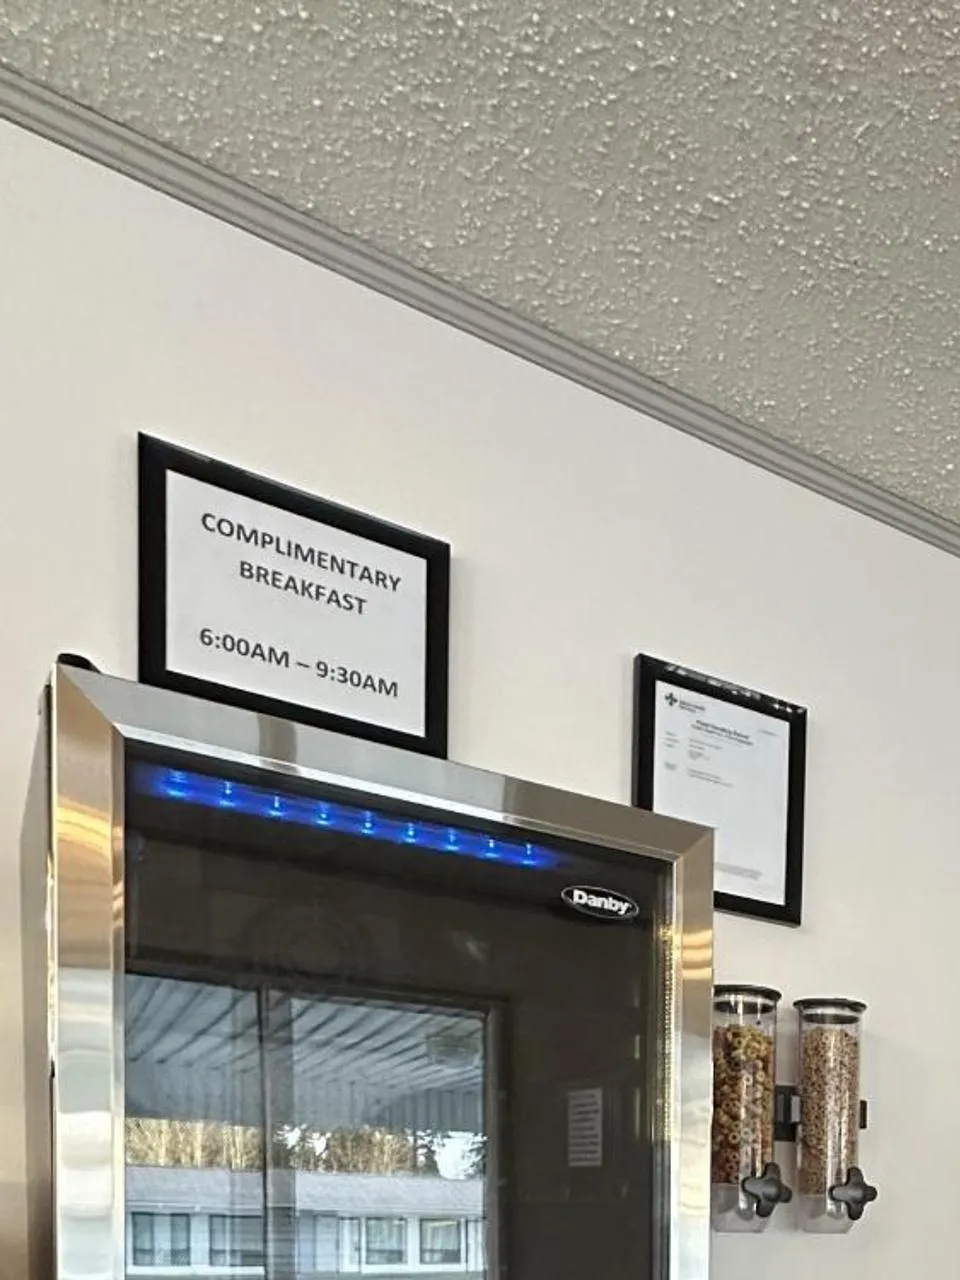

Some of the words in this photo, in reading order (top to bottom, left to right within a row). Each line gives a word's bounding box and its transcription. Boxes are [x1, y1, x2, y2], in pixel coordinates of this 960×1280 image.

[201, 512, 402, 592] COMPLIMENTARY
[239, 560, 367, 615] BREAKFAST
[199, 627, 290, 668] 6:00AM
[316, 660, 399, 698] 9:30AM
[572, 888, 631, 915] Danby
